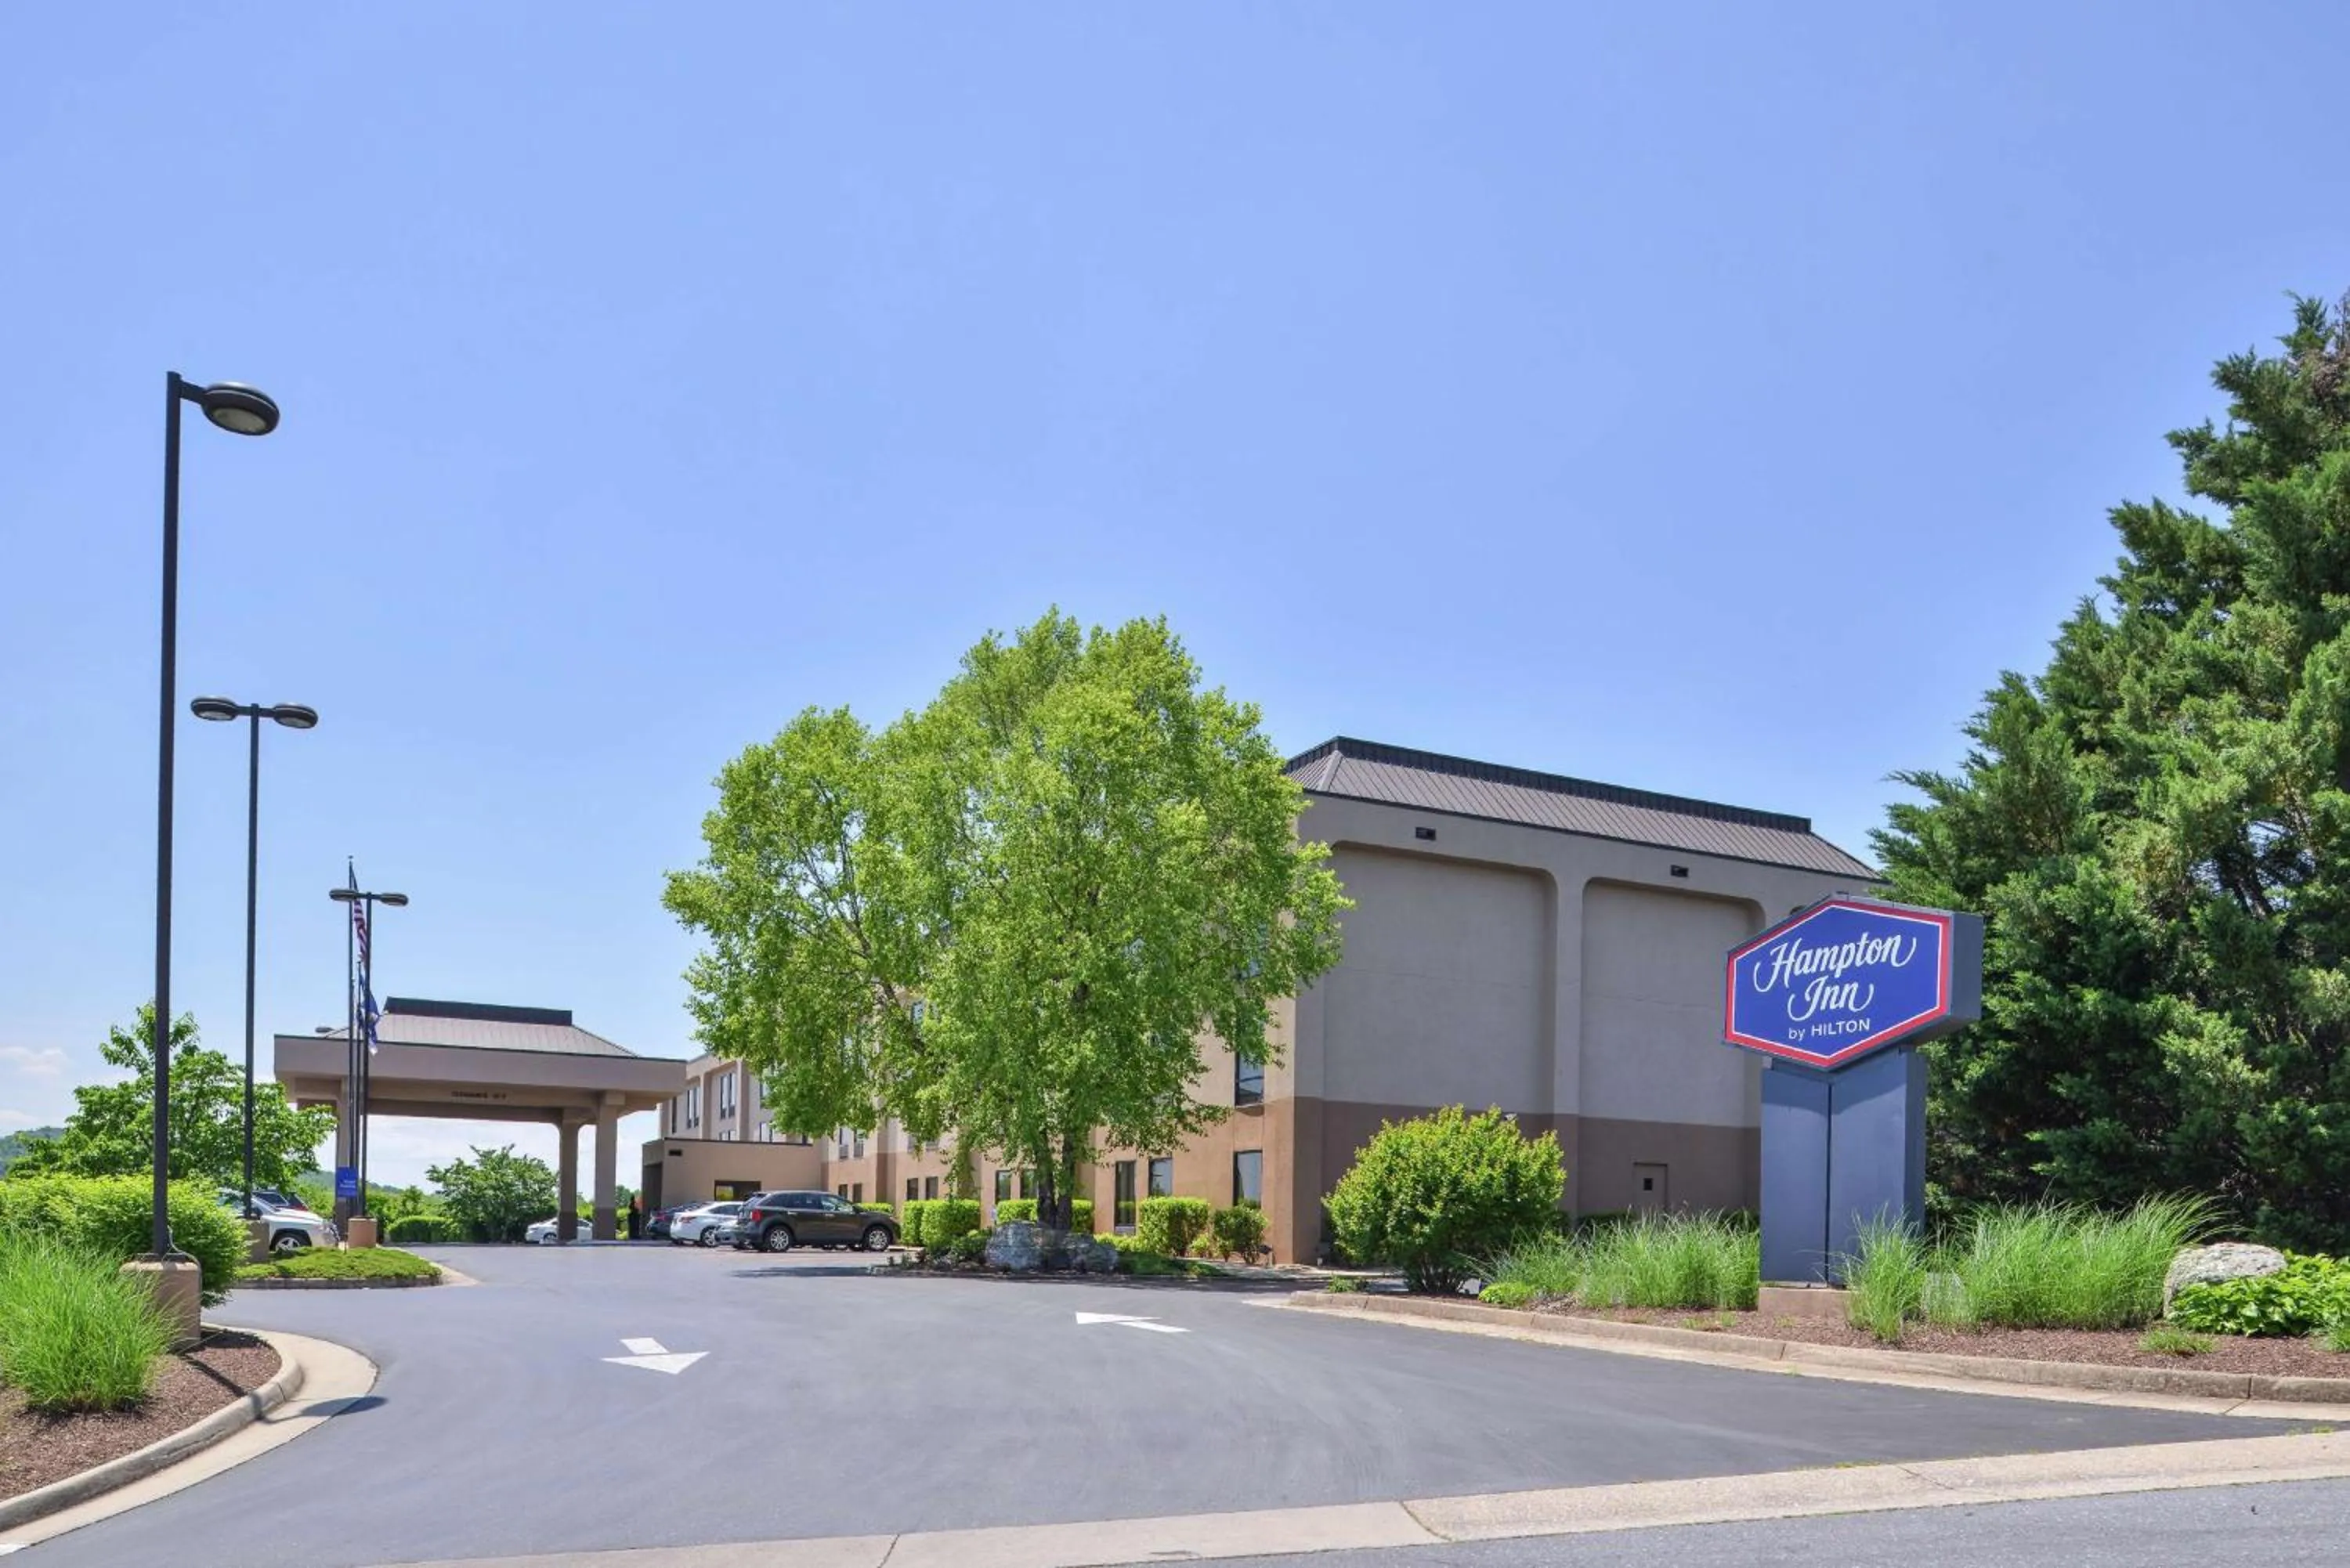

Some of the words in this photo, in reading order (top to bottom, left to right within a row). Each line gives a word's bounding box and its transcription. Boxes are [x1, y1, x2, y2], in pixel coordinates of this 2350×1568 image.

[1753, 932, 1917, 992] Hampton
[1787, 974, 1875, 1021] Inn
[1788, 1028, 1805, 1041] by
[1811, 1018, 1870, 1036] HILTON
